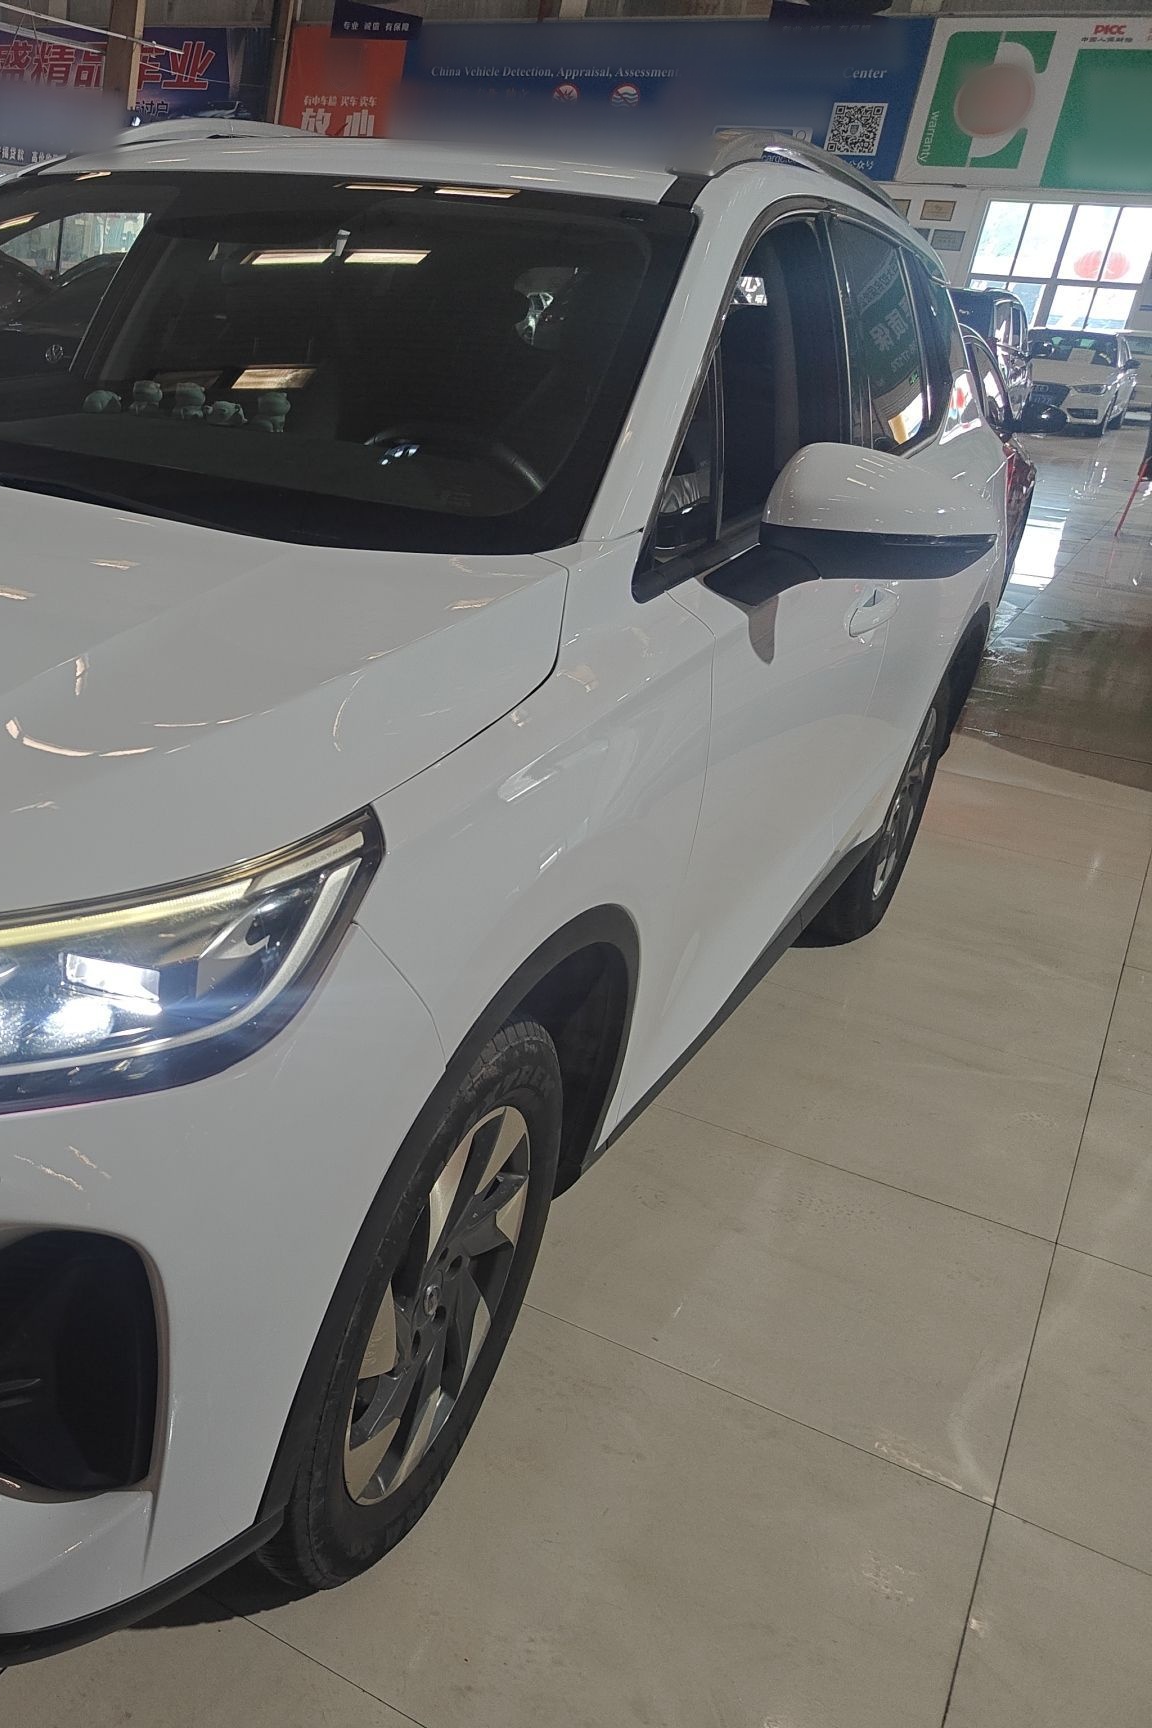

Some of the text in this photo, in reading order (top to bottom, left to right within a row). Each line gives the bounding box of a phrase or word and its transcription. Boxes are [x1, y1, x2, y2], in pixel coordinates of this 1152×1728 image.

[1093, 24, 1127, 35] PICC
[431, 66, 461, 77] China
[465, 66, 500, 77] Vehicle
[503, 67, 554, 78] Detection,
[556, 67, 612, 80] Appraisal,
[918, 110, 940, 163] warranty
